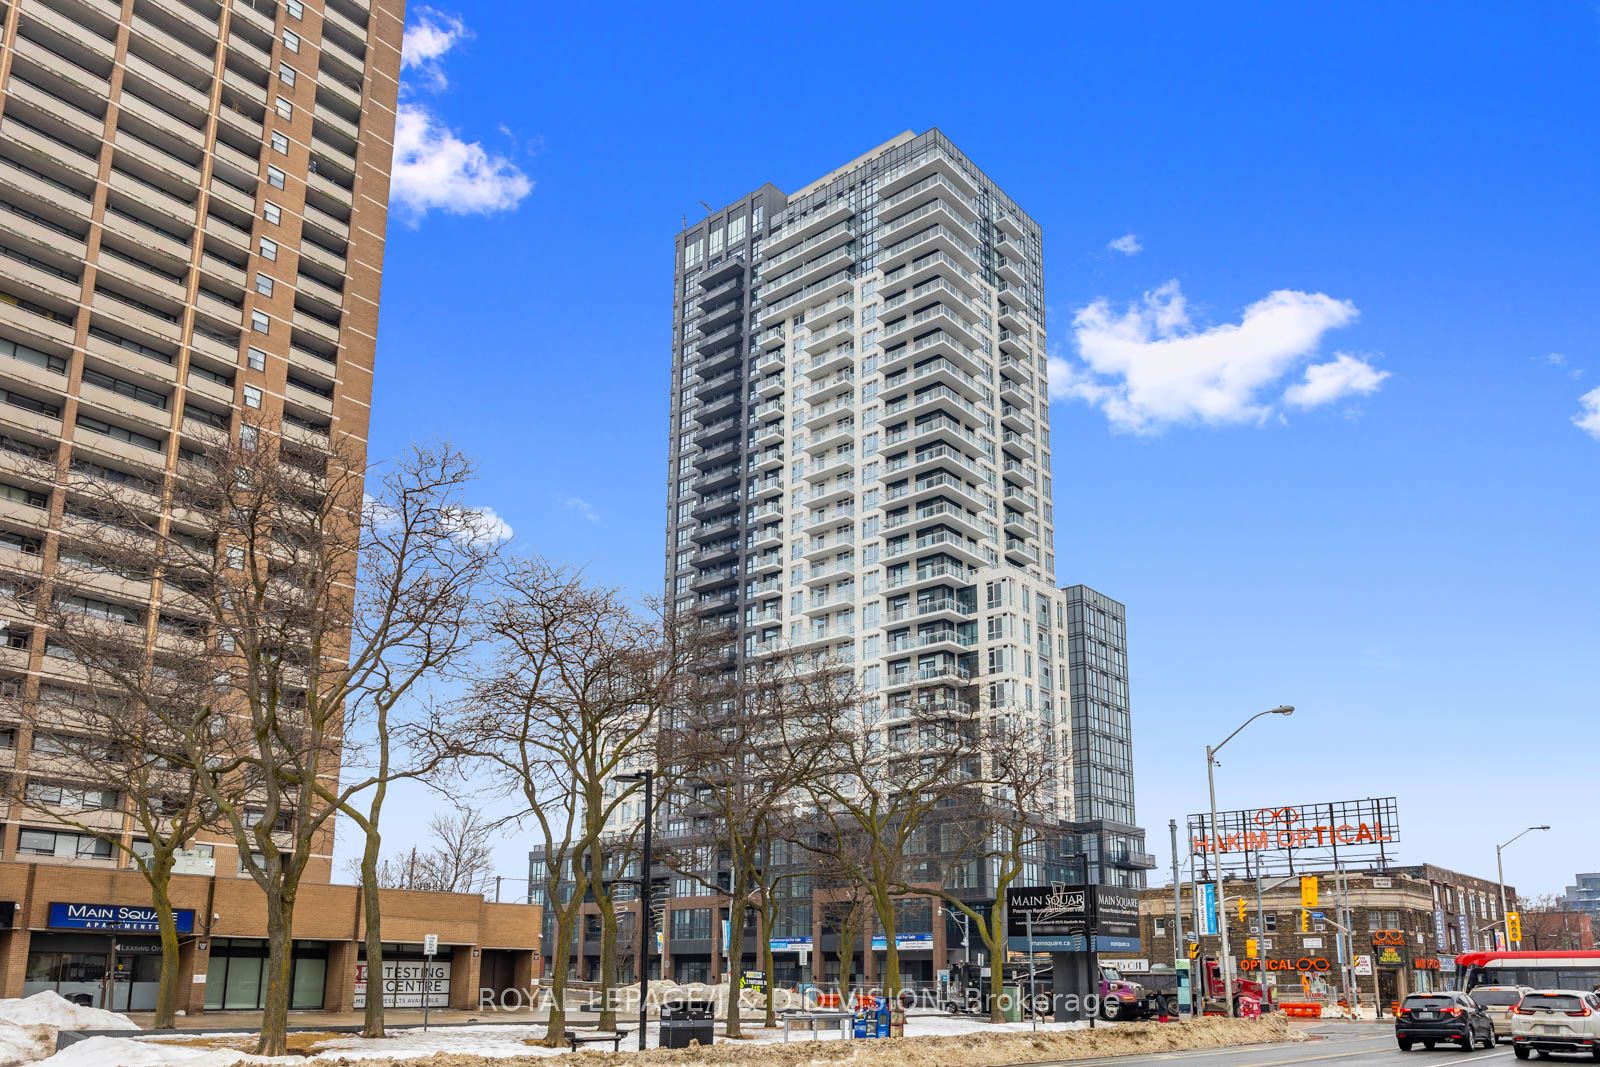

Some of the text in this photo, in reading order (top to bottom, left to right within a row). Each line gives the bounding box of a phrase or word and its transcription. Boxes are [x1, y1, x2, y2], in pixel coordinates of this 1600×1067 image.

[1193, 821, 1392, 852] HAKIM OPTICAL
[1011, 894, 1085, 907] MAIN SQUAR
[1098, 894, 1138, 909] MAIN SQUARE
[68, 905, 178, 921] MAIN SQUAE
[1435, 911, 1445, 949] PHARMACY
[1240, 959, 1296, 971] OPTICAL
[385, 967, 444, 978] TESTING
[386, 981, 442, 992] CENTRE
